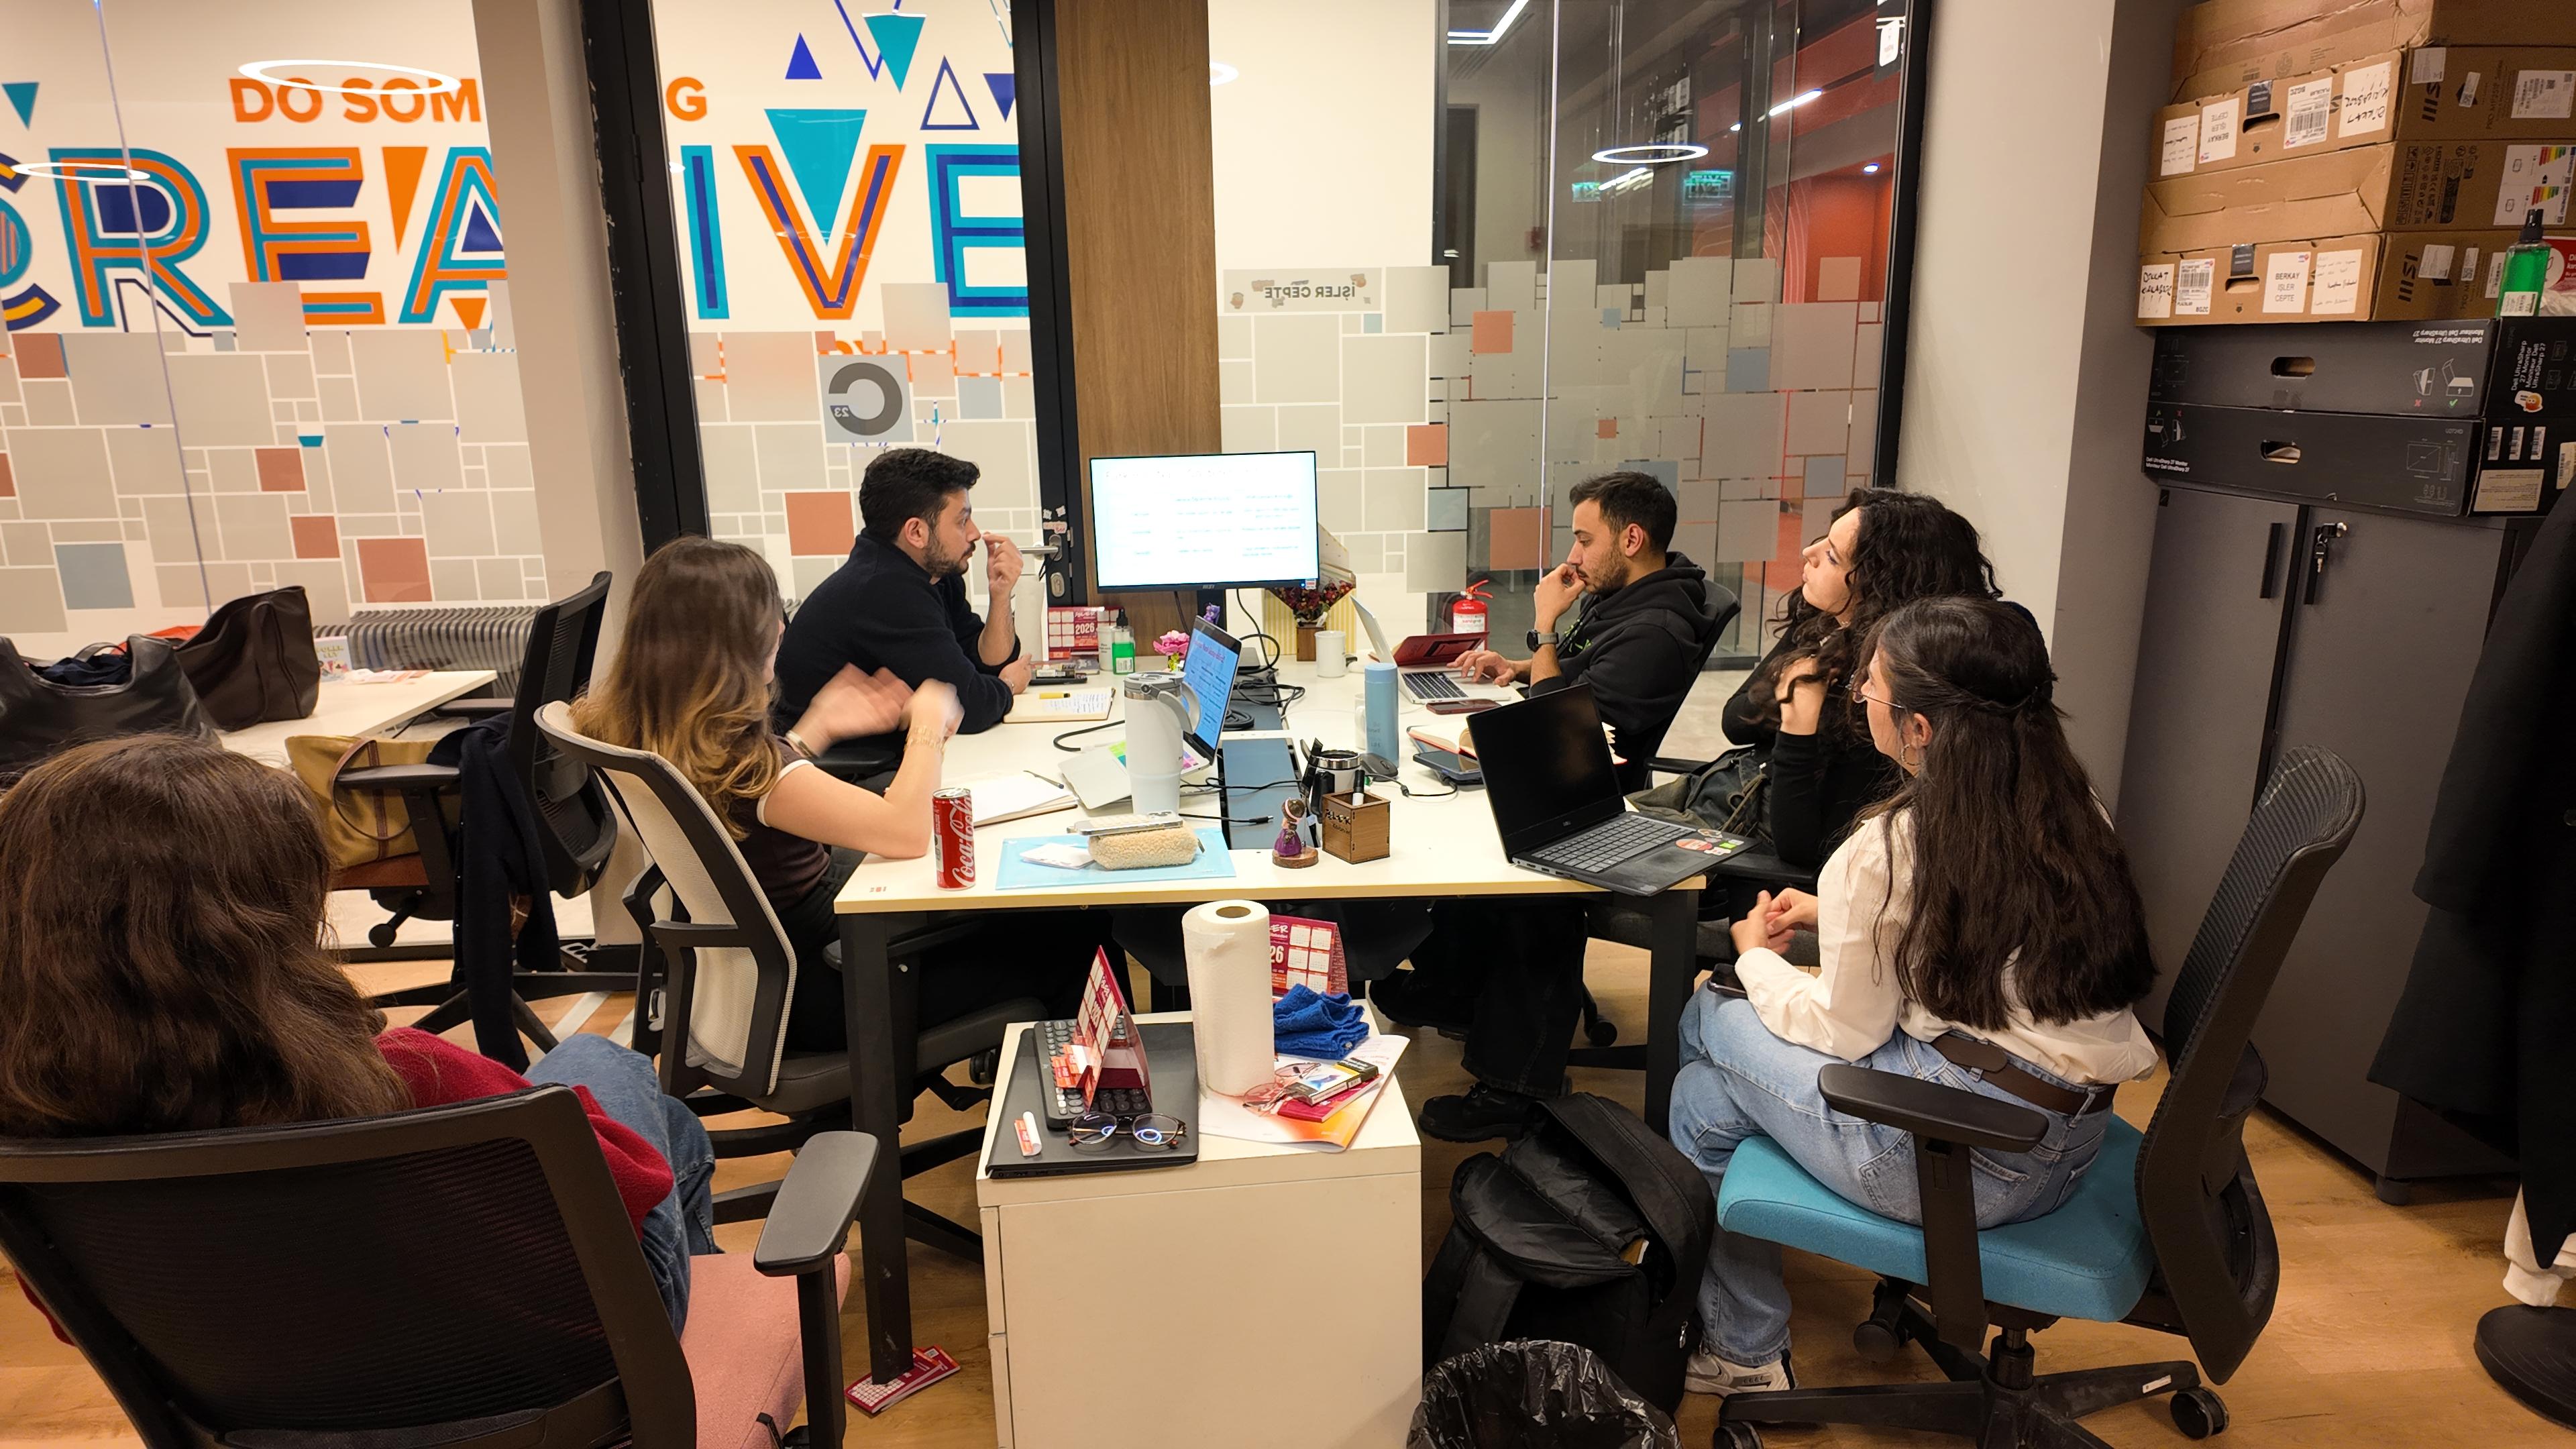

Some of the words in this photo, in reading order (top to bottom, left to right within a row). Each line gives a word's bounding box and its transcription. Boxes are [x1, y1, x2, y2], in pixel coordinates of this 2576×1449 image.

[229, 77, 323, 123] DO
[2207, 131, 2230, 143] BERKAY
[2275, 272, 2300, 280] BERKAY
[2530, 343, 2539, 356] Dell
[2513, 340, 2528, 376] UltraSharp
[2521, 346, 2532, 373] Monitor
[2531, 352, 2545, 388] UltraSharp
[2539, 343, 2546, 352] 27
[2519, 374, 2526, 383] 27
[2525, 358, 2536, 388] Moniteur
[2510, 377, 2520, 391] Dell
[1075, 622, 1095, 635] 2026
[949, 794, 977, 888] Coca-Cola
[1270, 924, 1289, 933] ER
[1270, 945, 1285, 963] 26
